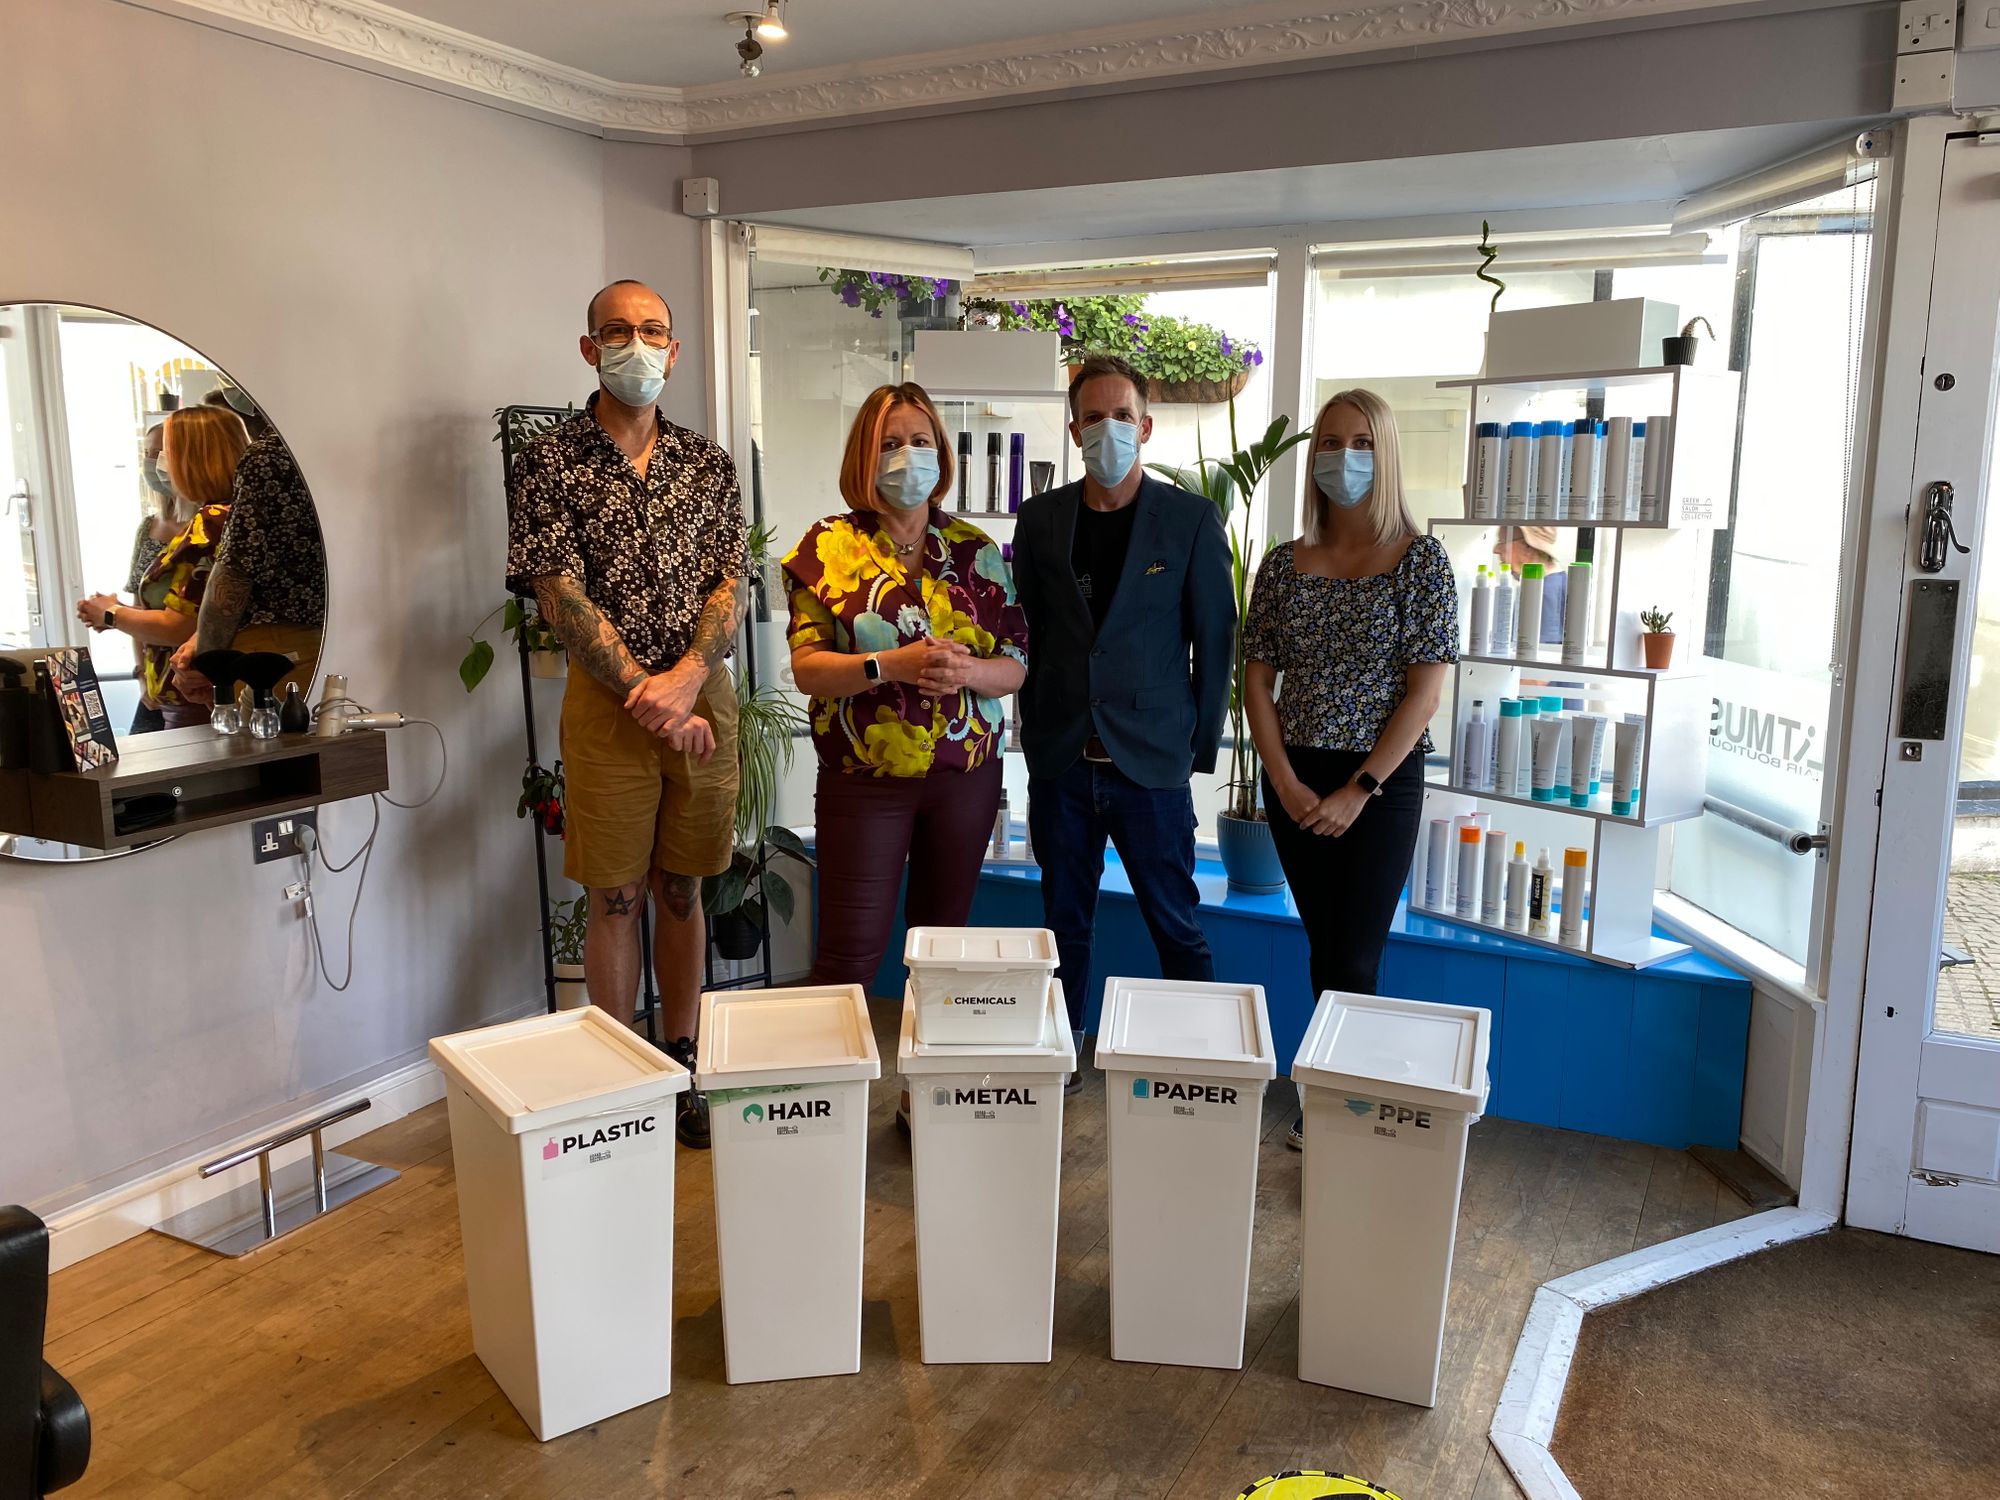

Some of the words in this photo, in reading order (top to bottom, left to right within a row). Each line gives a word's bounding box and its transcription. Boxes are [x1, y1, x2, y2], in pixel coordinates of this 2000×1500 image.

[954, 997, 1016, 1005] CHEMICALS
[955, 1088, 1037, 1105] METAL
[1153, 1081, 1238, 1105] PAPER
[768, 1100, 831, 1121] HAIR
[1379, 1103, 1431, 1129] PPE
[562, 1116, 656, 1154] PLASTIC
